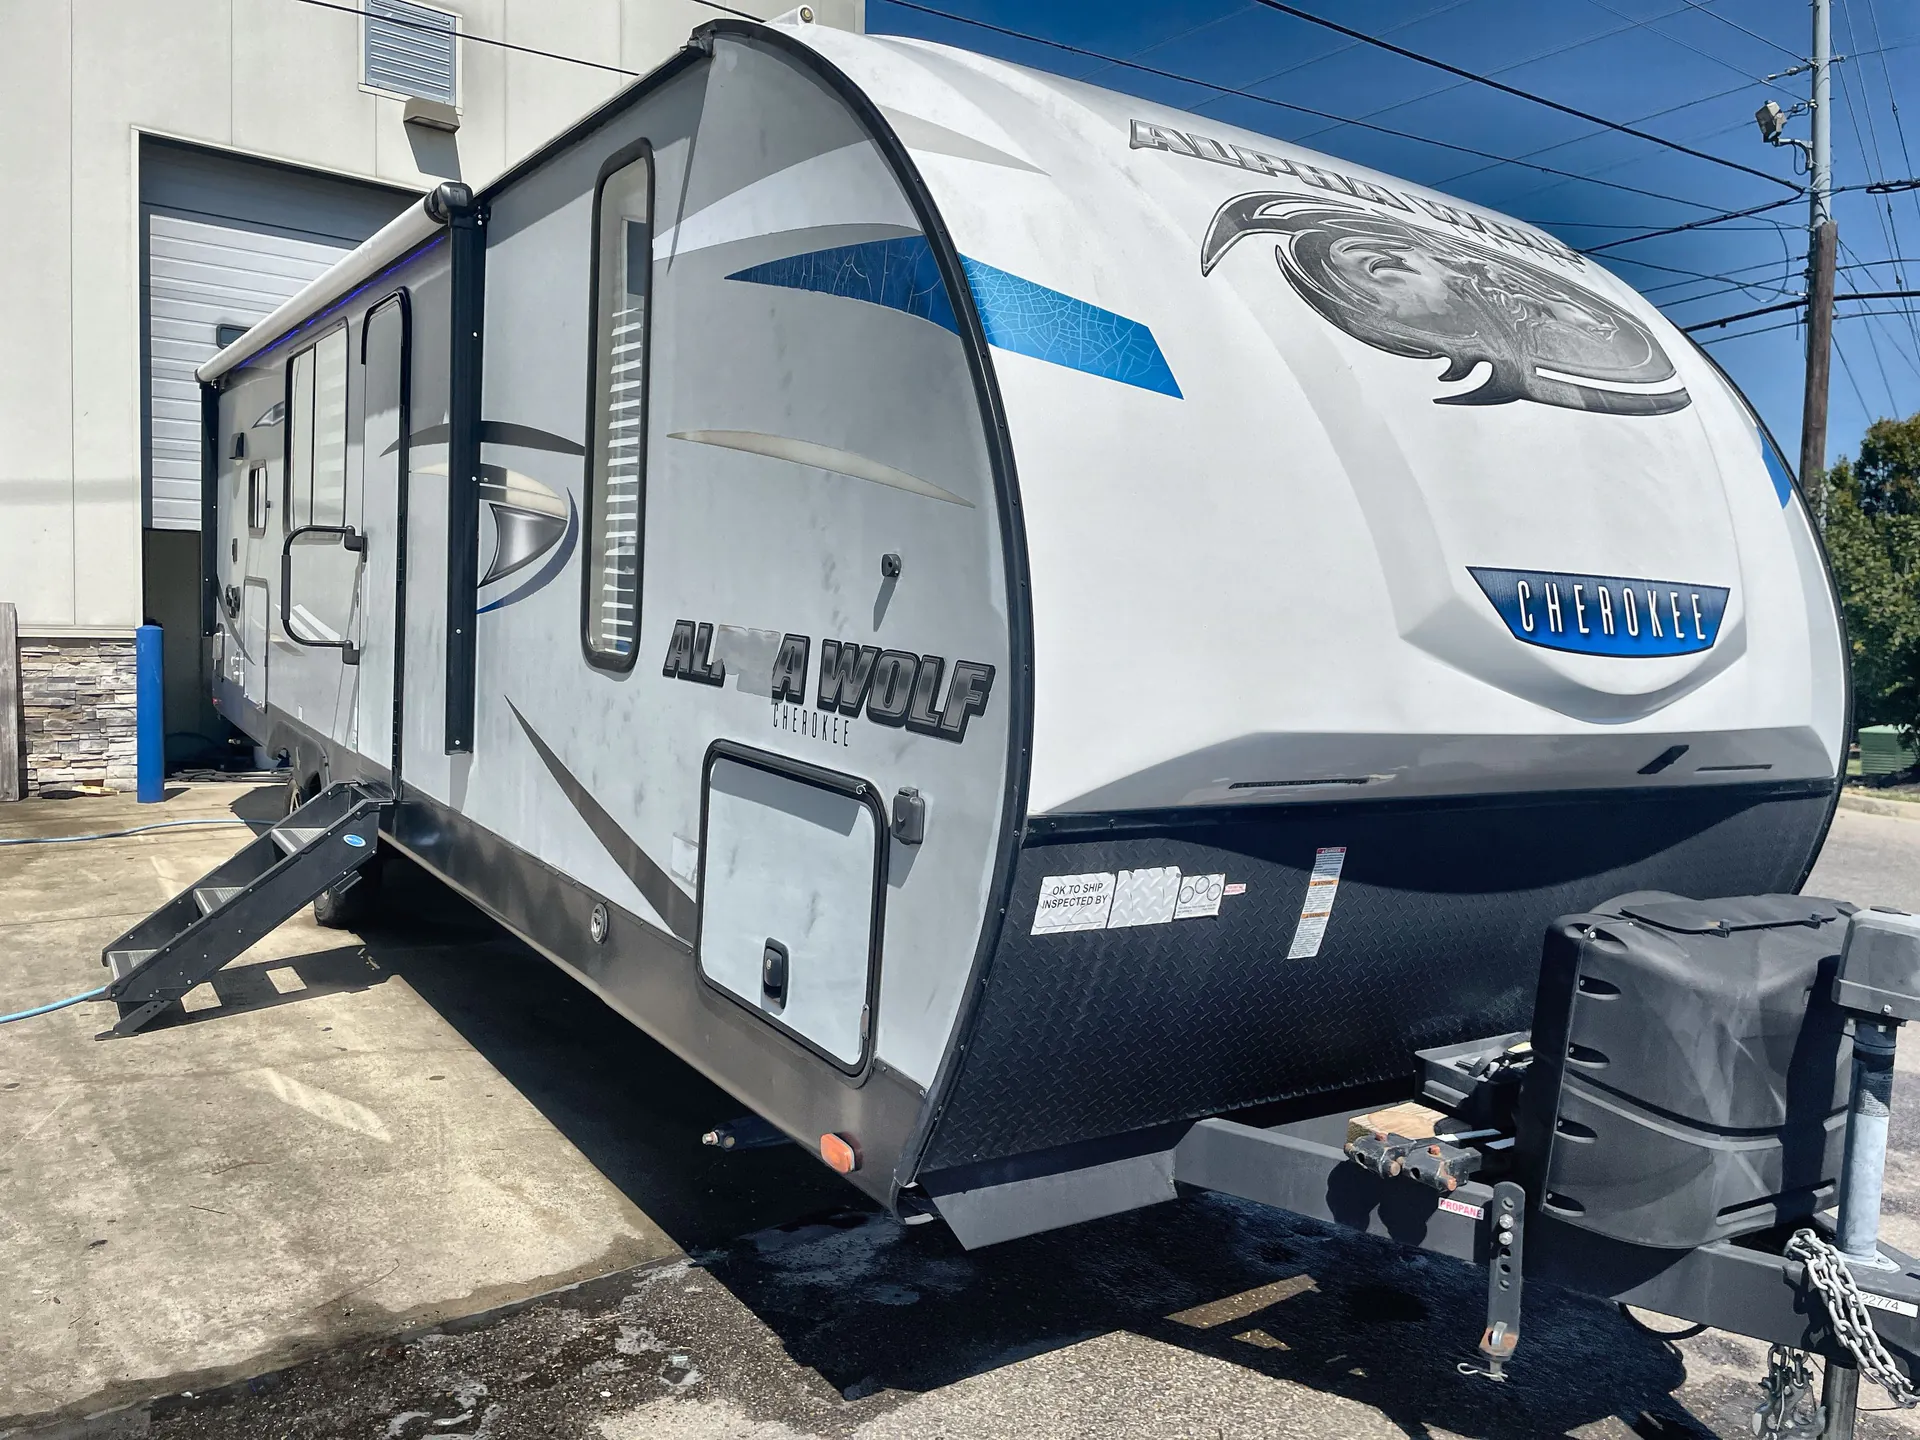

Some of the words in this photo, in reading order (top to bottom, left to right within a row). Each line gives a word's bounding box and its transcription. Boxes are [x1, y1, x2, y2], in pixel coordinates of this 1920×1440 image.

[1130, 119, 1415, 214] ALPHA
[1517, 580, 1706, 640] CHEROKEE
[663, 619, 810, 705] ALA
[817, 638, 996, 745] WOLF
[773, 702, 850, 747] CHEROKEE
[1041, 896, 1094, 909] INSPECTED
[1095, 895, 1108, 904] BY
[1052, 885, 1067, 896] OK
[1069, 884, 1081, 894] TO
[1082, 883, 1104, 893] SHIP
[1440, 1199, 1483, 1218] PROPANE
[1859, 1292, 1899, 1311] 22774
